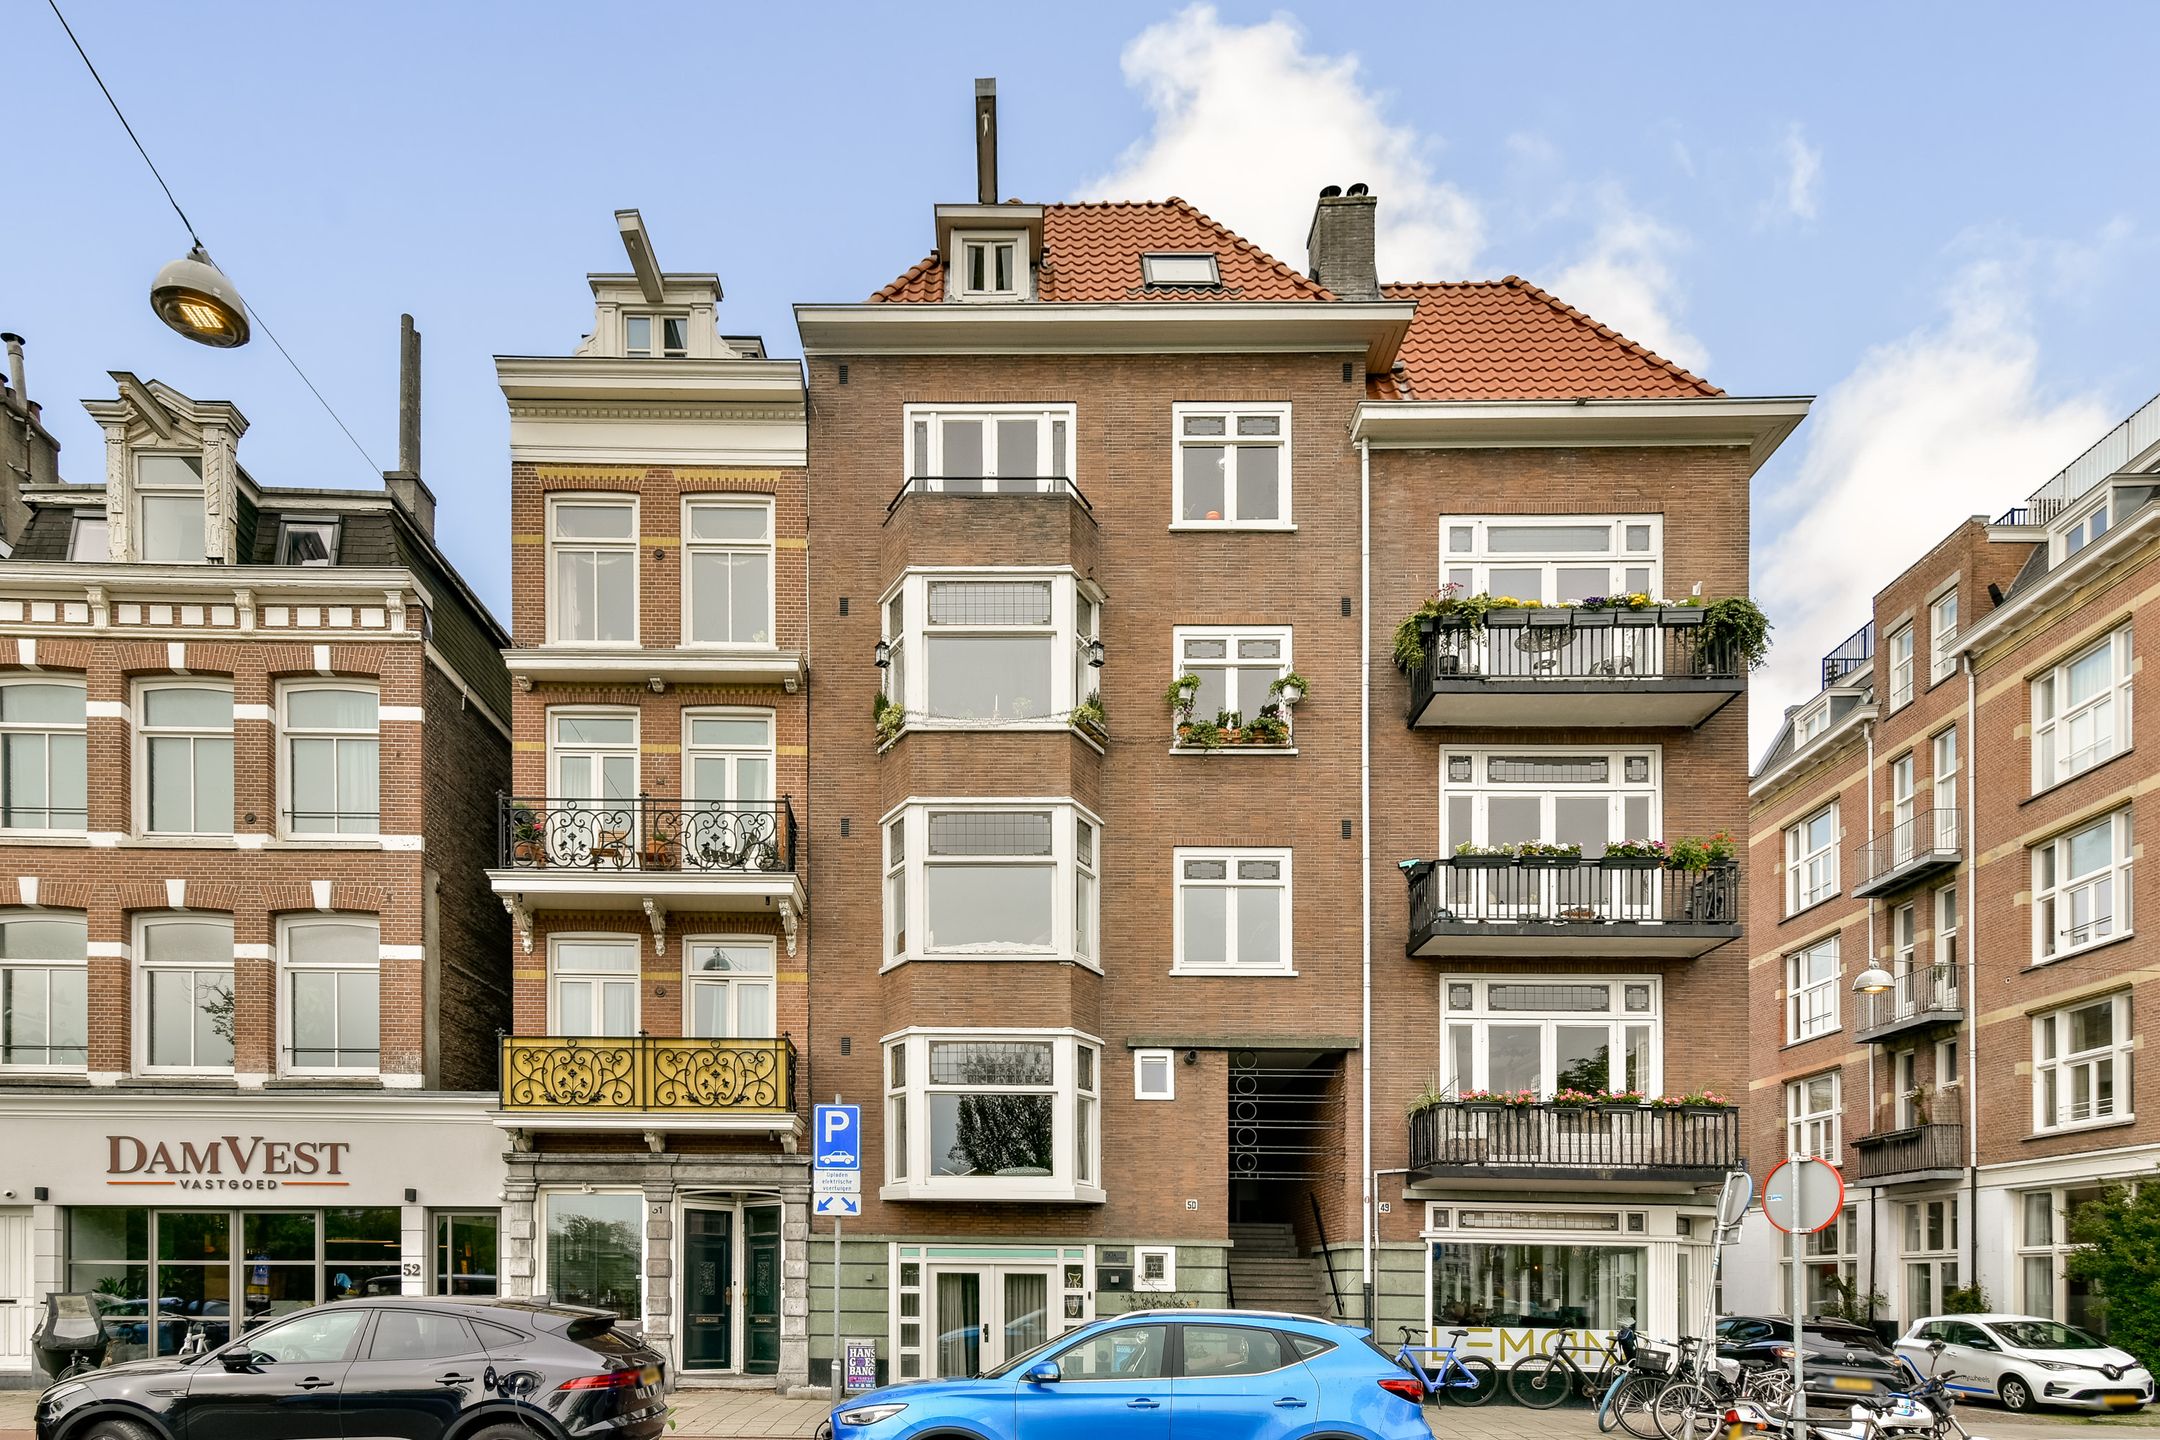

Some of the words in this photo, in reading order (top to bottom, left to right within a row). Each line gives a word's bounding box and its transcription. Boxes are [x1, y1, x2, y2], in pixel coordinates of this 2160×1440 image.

[825, 1110, 850, 1142] P
[179, 1179, 278, 1190] VASTGOED
[1187, 1200, 1196, 1209] 50
[1380, 1203, 1390, 1211] 49
[402, 1263, 421, 1277] 52
[1431, 1327, 1628, 1365] LEMON
[849, 1348, 875, 1357] HANS
